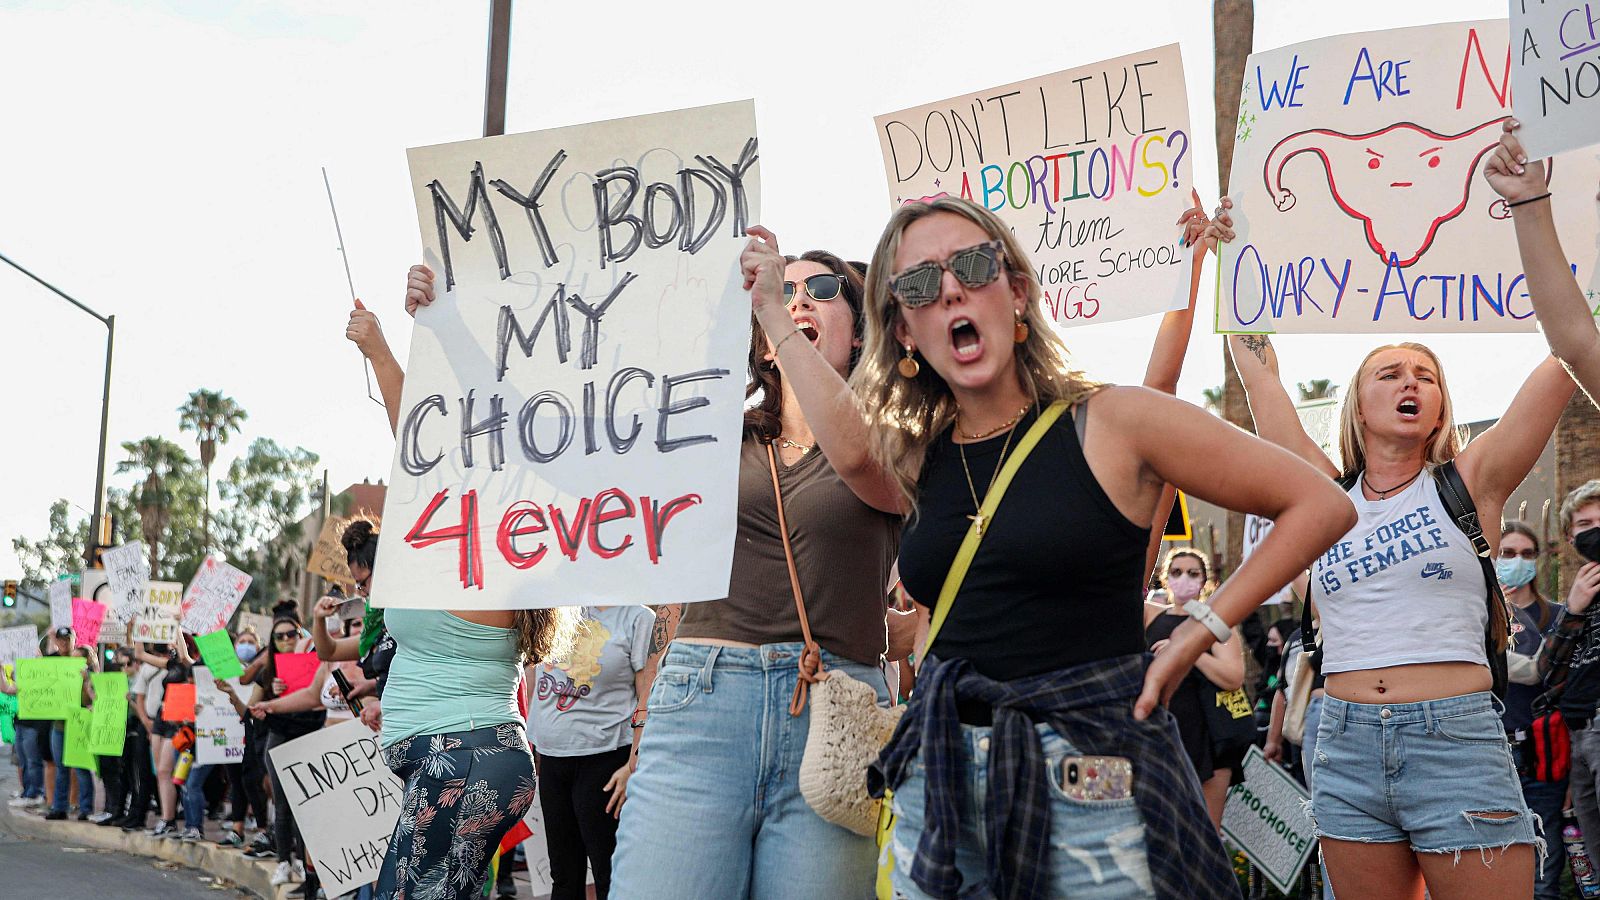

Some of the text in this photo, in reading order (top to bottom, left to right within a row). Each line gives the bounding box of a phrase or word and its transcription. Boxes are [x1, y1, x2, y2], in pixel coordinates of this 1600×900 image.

[1257, 28, 1512, 111] WE ARE N
[1521, 27, 1541, 66] A
[885, 61, 1166, 183] DON'T LIKE
[960, 129, 1189, 215] ABORTIONS?
[425, 149, 568, 293] MY
[592, 137, 758, 269] BODY
[1034, 206, 1125, 254] them
[1099, 243, 1182, 278] SCHOOL
[1233, 245, 1576, 326] OVARY-ACTING
[497, 271, 637, 382] MY
[401, 367, 730, 477] CHOICE
[1318, 527, 1449, 596] IS FEMALE
[1365, 505, 1437, 551] FORCE
[1425, 562, 1446, 572] NIKE
[1437, 570, 1453, 580] AIR
[1232, 782, 1307, 854] PROCHOICE
